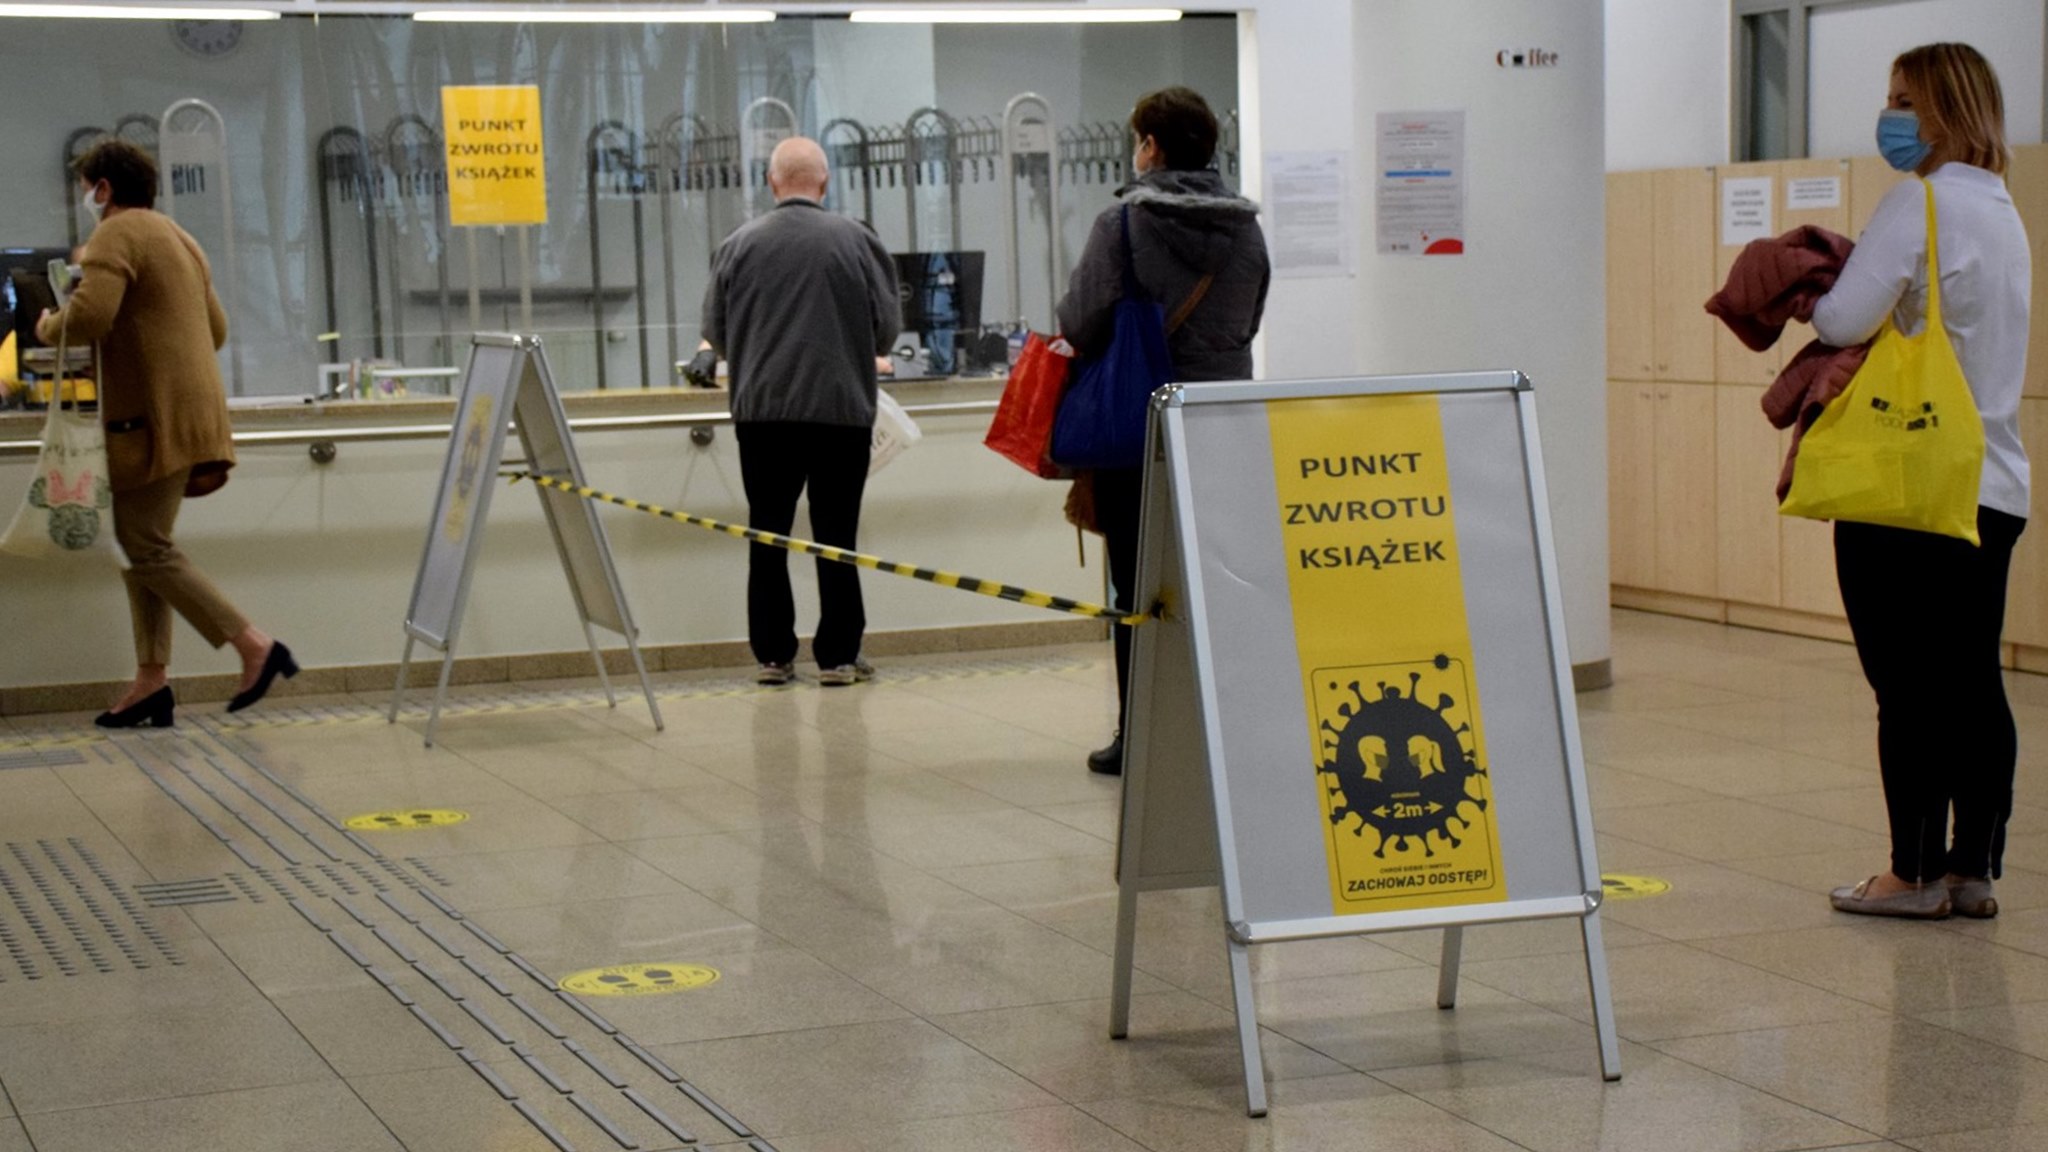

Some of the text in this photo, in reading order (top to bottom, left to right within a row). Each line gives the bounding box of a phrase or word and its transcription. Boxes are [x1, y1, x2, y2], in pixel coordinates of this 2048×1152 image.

[1496, 48, 1559, 68] Cffee
[459, 119, 526, 132] PUNKT
[450, 143, 539, 156] ZWROTU
[456, 166, 536, 182] KSIĄŻEK
[1300, 452, 1422, 479] PUNKT
[1285, 496, 1446, 525] ZWROTU
[1300, 538, 1446, 570] KSIĄŻEK
[1393, 802, 1423, 818] 2m
[1348, 869, 1487, 892] ZACHOWAJ ODSTĘP!
